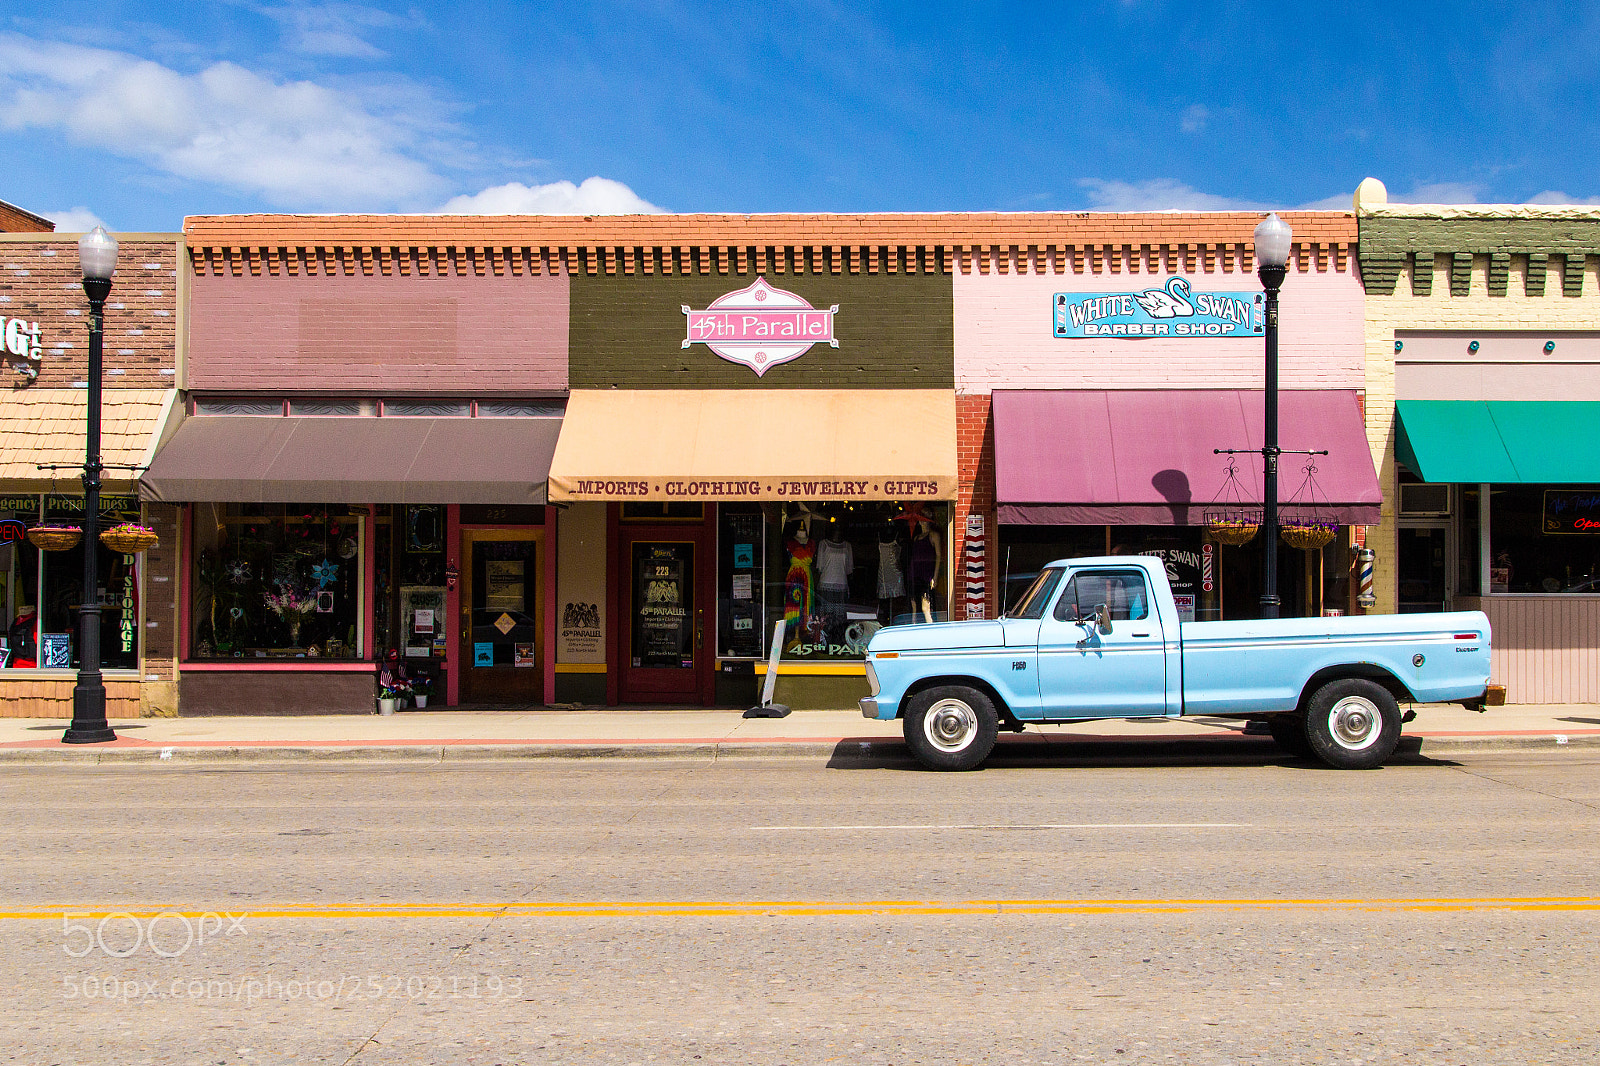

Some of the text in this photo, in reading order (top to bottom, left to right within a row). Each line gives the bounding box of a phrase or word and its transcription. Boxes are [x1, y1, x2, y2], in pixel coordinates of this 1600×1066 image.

[1069, 295, 1250, 329] WHITE SWAN
[691, 313, 828, 339] 45th Parallel
[1084, 324, 1236, 336] BARBER SHOP
[0, 316, 30, 357] G
[569, 480, 938, 496] MPORTS CLOTHING JEWELRY GIFTS
[48, 497, 128, 511] Prepaness
[1169, 549, 1200, 570] SWAN
[656, 566, 669, 575] 223
[120, 575, 133, 652] STORAGE
[789, 643, 826, 655] 45th
